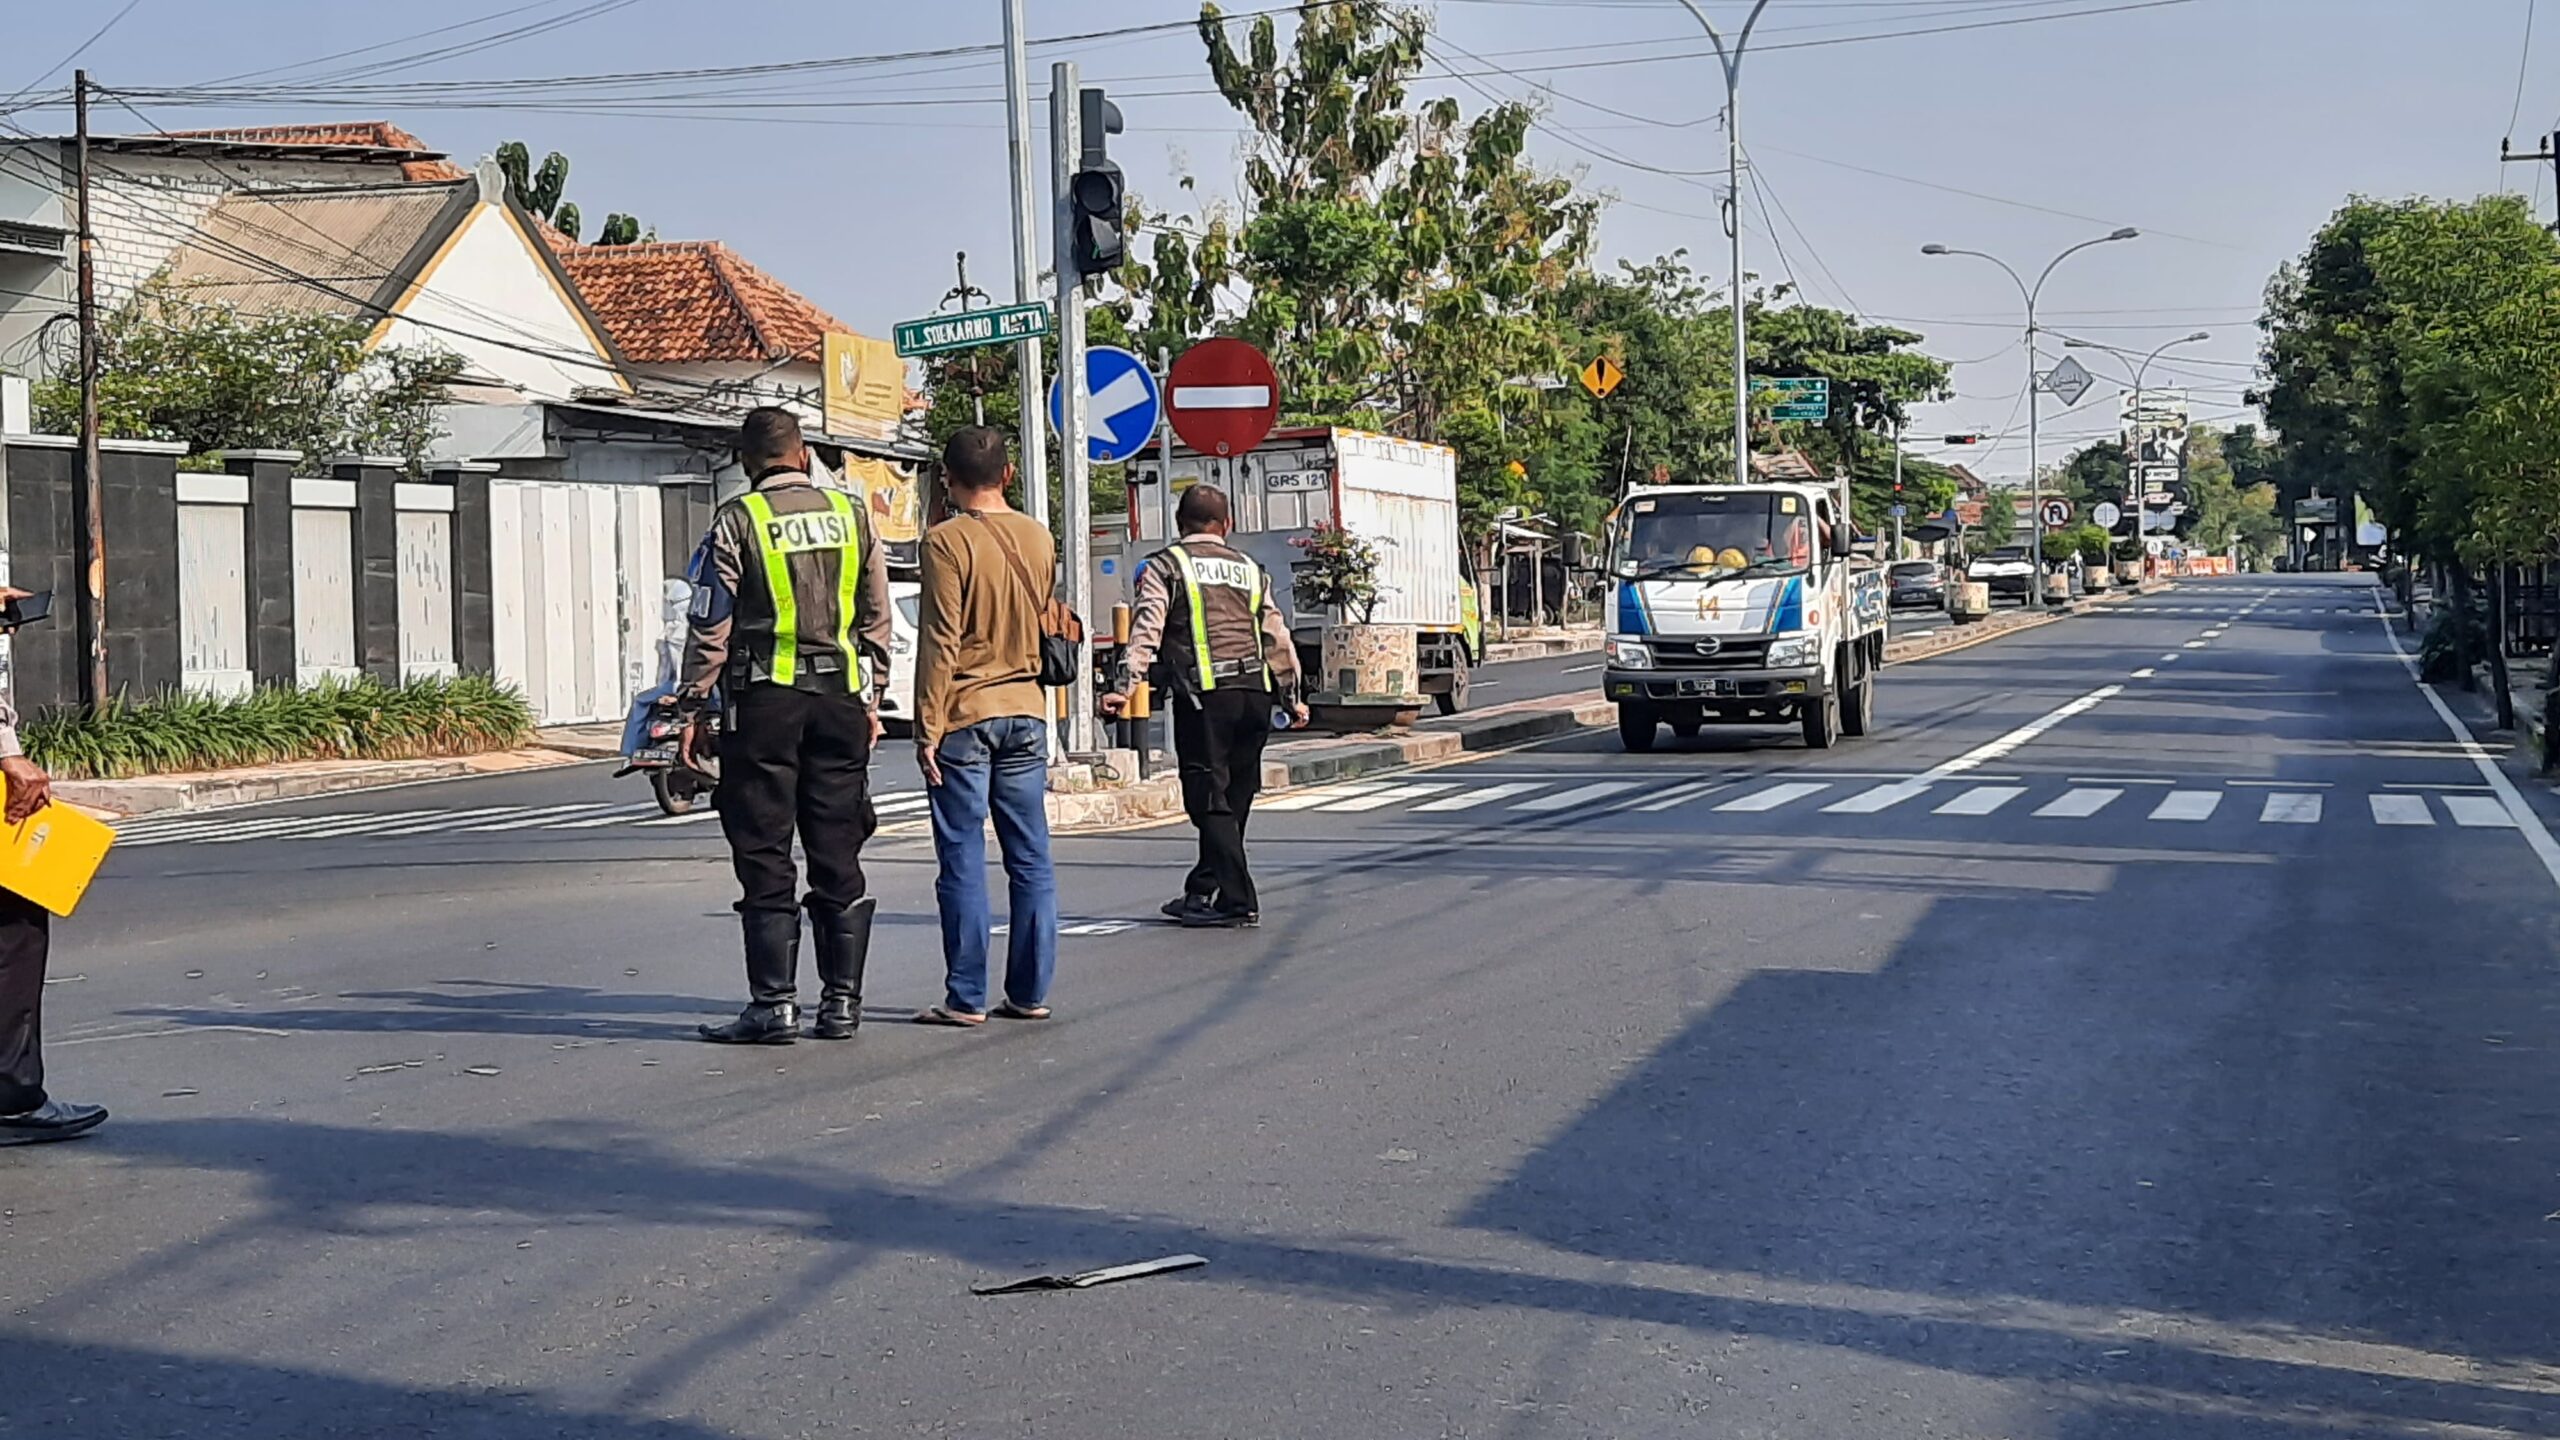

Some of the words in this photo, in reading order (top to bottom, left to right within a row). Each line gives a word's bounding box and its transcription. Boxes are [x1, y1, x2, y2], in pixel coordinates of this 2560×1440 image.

[923, 317, 992, 346] SOEKARNO
[1268, 474, 1300, 487] GRS
[766, 516, 850, 550] POLISI
[1195, 562, 1248, 586] POLISI
[1696, 594, 1721, 621] 14
